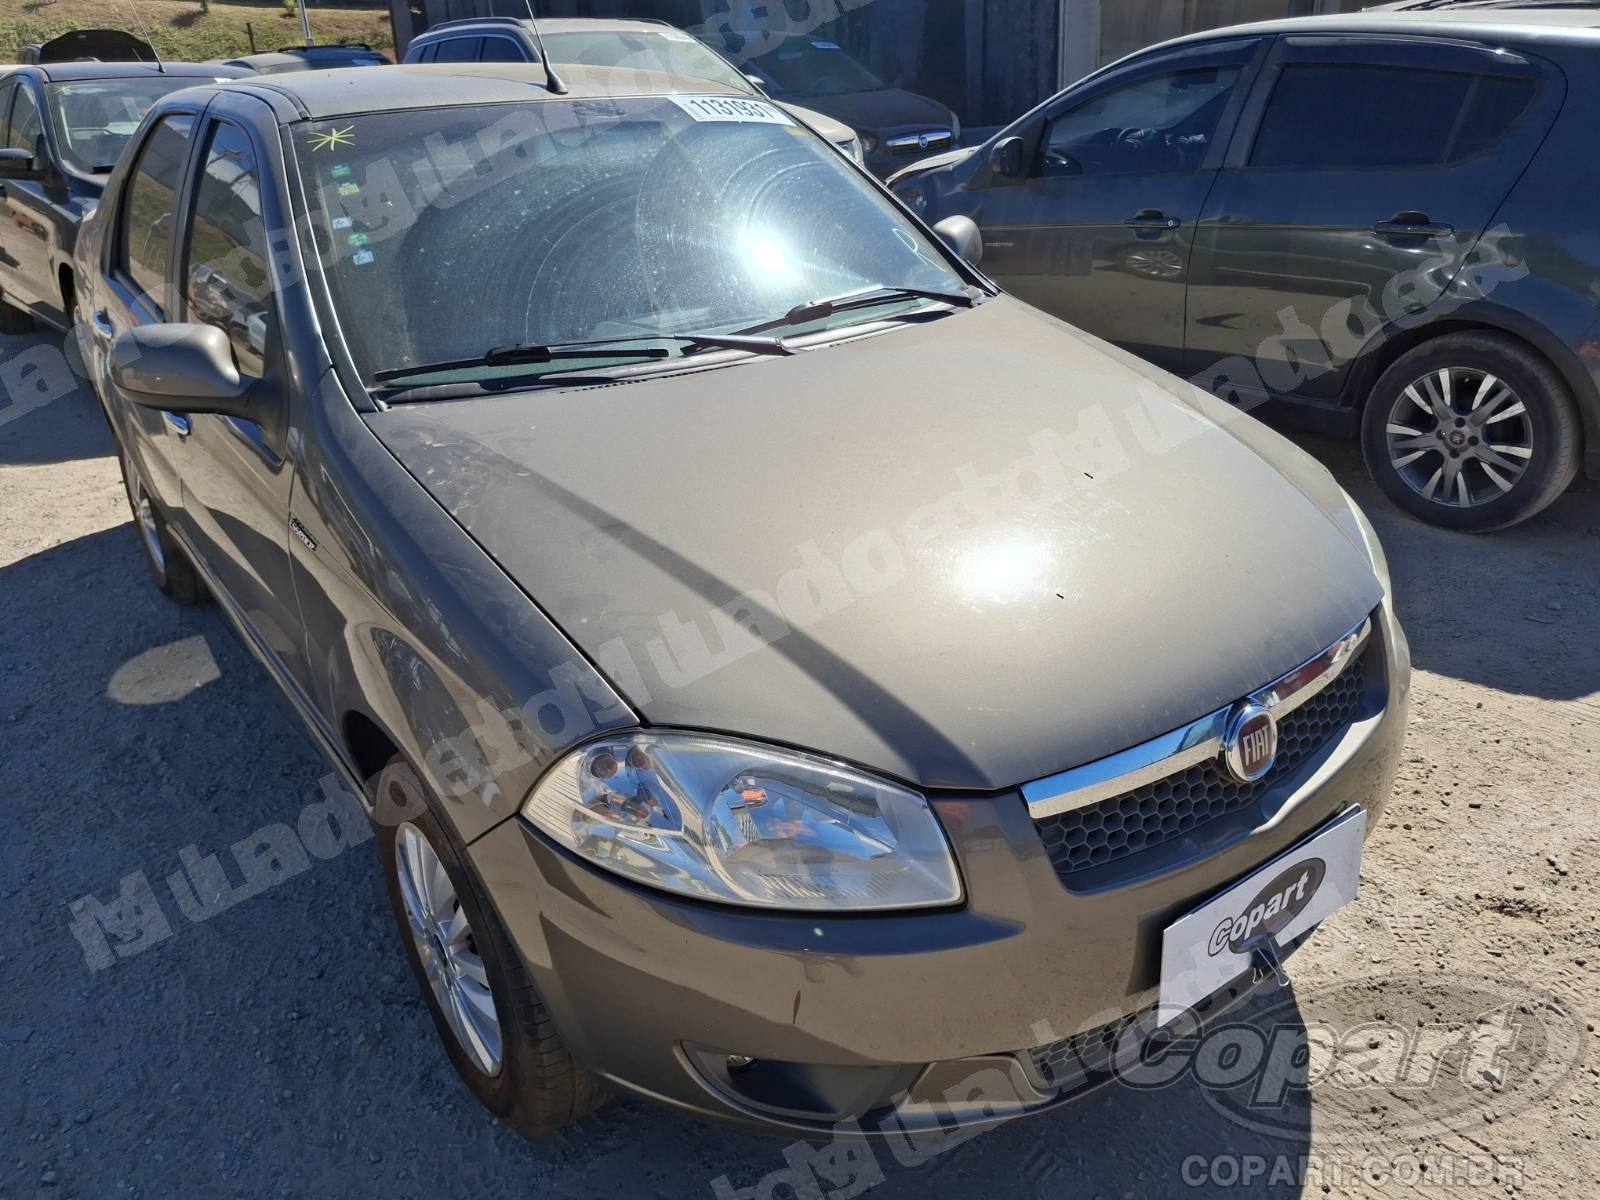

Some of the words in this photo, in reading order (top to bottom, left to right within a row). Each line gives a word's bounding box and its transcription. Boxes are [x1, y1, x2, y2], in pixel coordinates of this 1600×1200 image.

[689, 99, 774, 118] 1131931
[1242, 725, 1269, 766] FIAT
[1207, 870, 1310, 957] Copart
